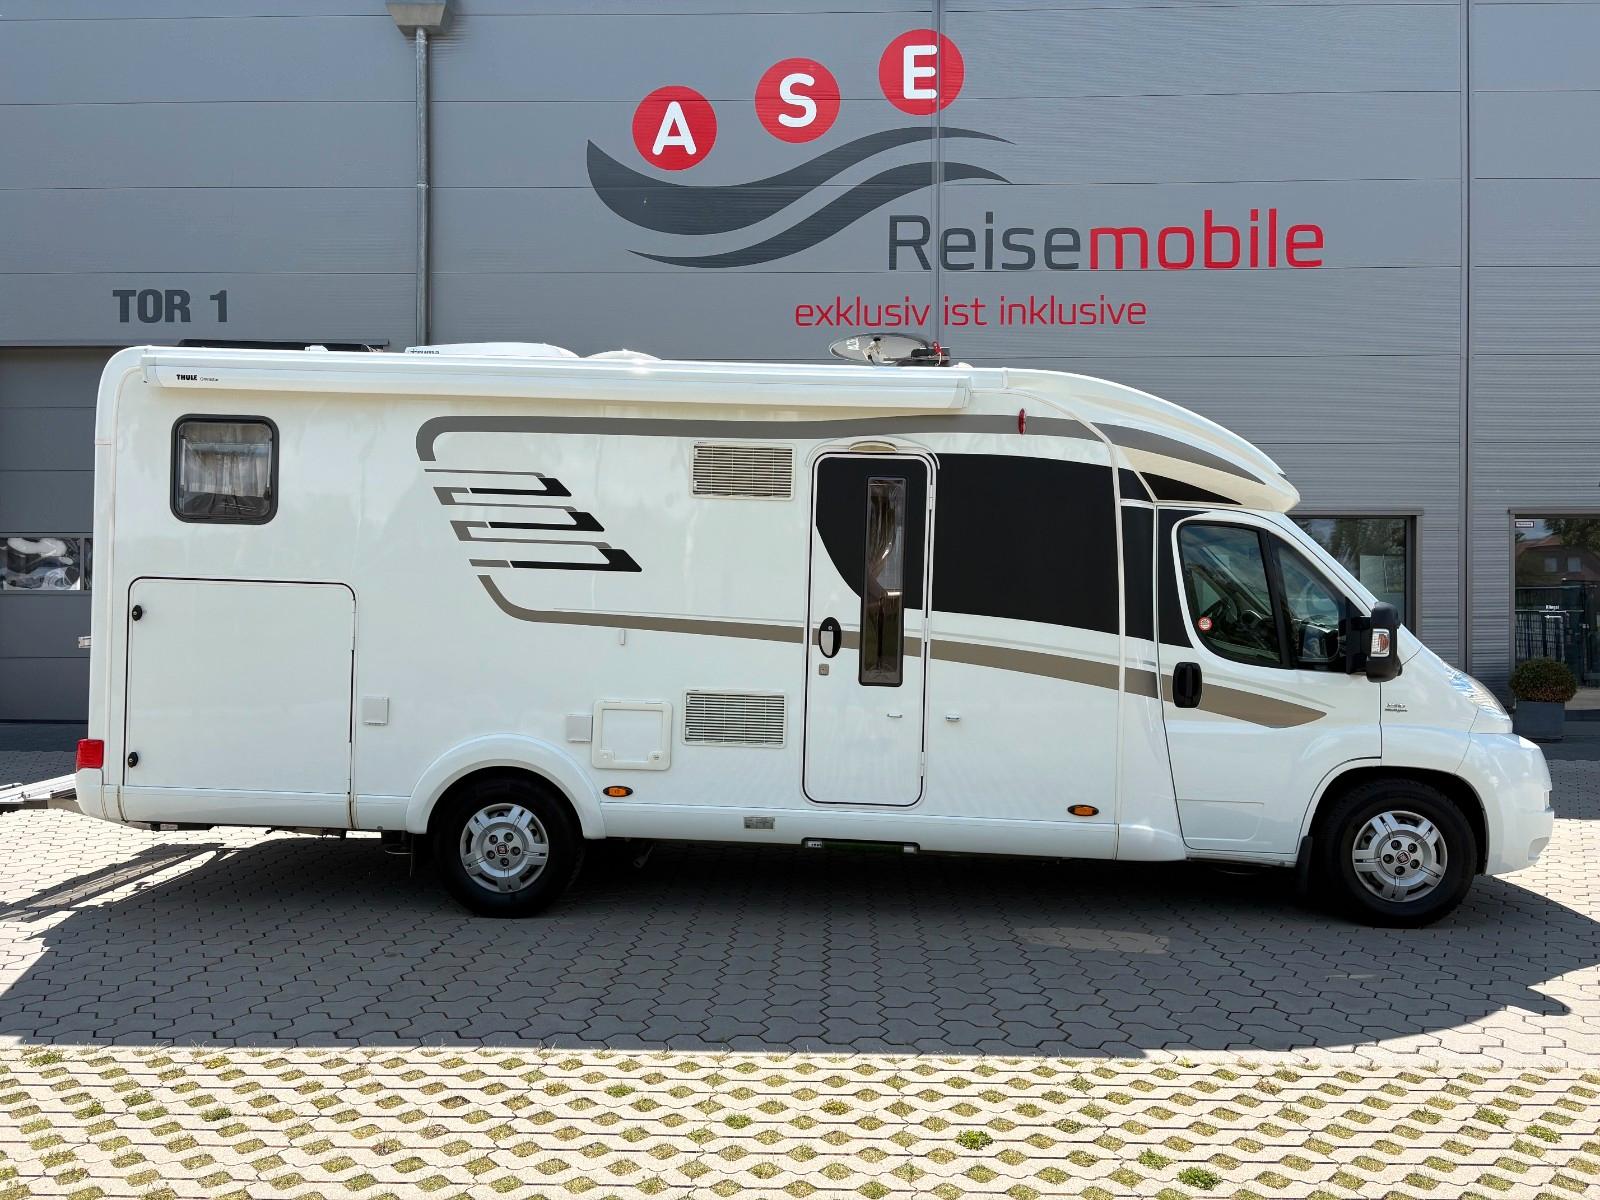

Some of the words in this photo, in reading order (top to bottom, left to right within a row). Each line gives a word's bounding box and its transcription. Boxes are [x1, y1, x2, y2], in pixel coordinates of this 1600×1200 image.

[651, 100, 697, 156] A
[777, 72, 818, 128] S
[902, 44, 938, 100] E
[888, 208, 1324, 272] Reisemobile
[112, 289, 191, 323] TOR
[209, 289, 228, 323] 1
[794, 297, 930, 328] exklusiv
[943, 297, 987, 326] ist
[1000, 294, 1148, 326] inklusive
